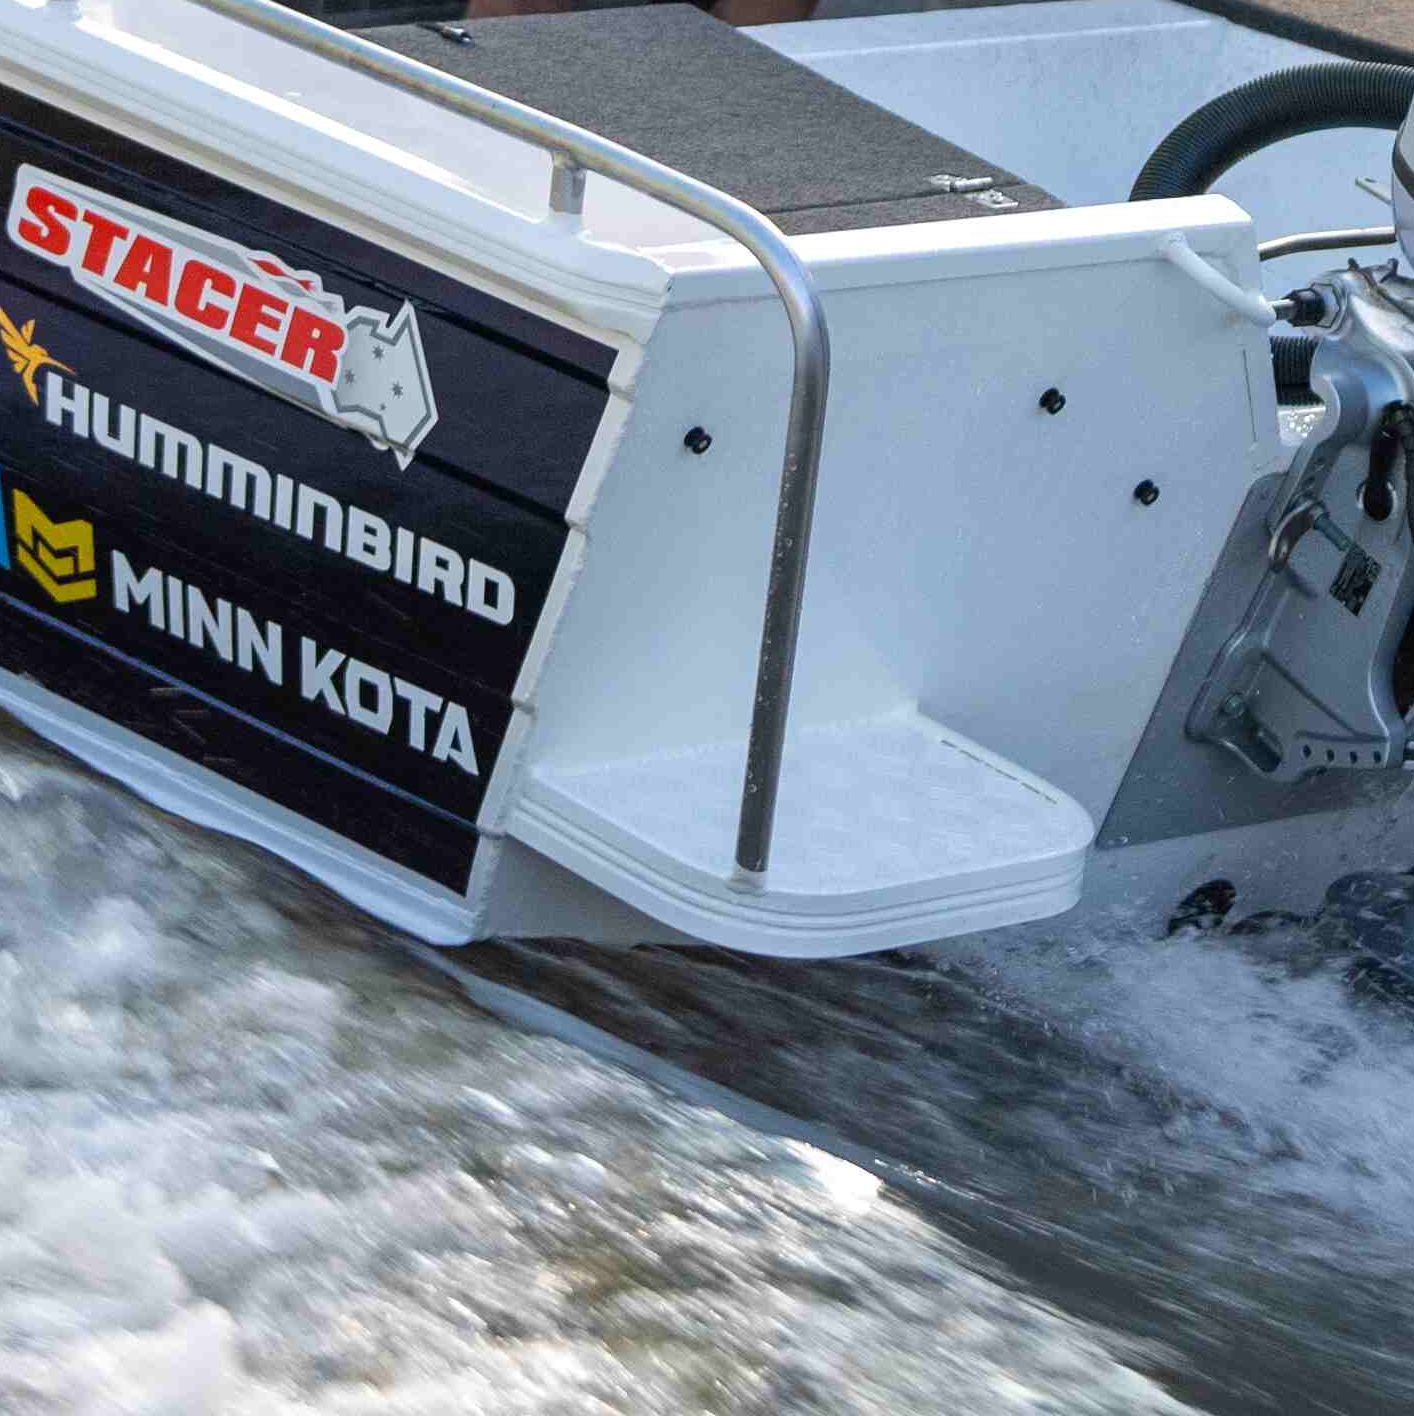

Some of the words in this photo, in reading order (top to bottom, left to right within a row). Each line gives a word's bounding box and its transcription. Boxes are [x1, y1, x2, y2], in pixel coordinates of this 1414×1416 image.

[17, 185, 347, 384] STACER
[45, 372, 515, 626] HUMMINBIRD
[112, 548, 283, 686] MINN
[300, 638, 480, 776] KOTA
